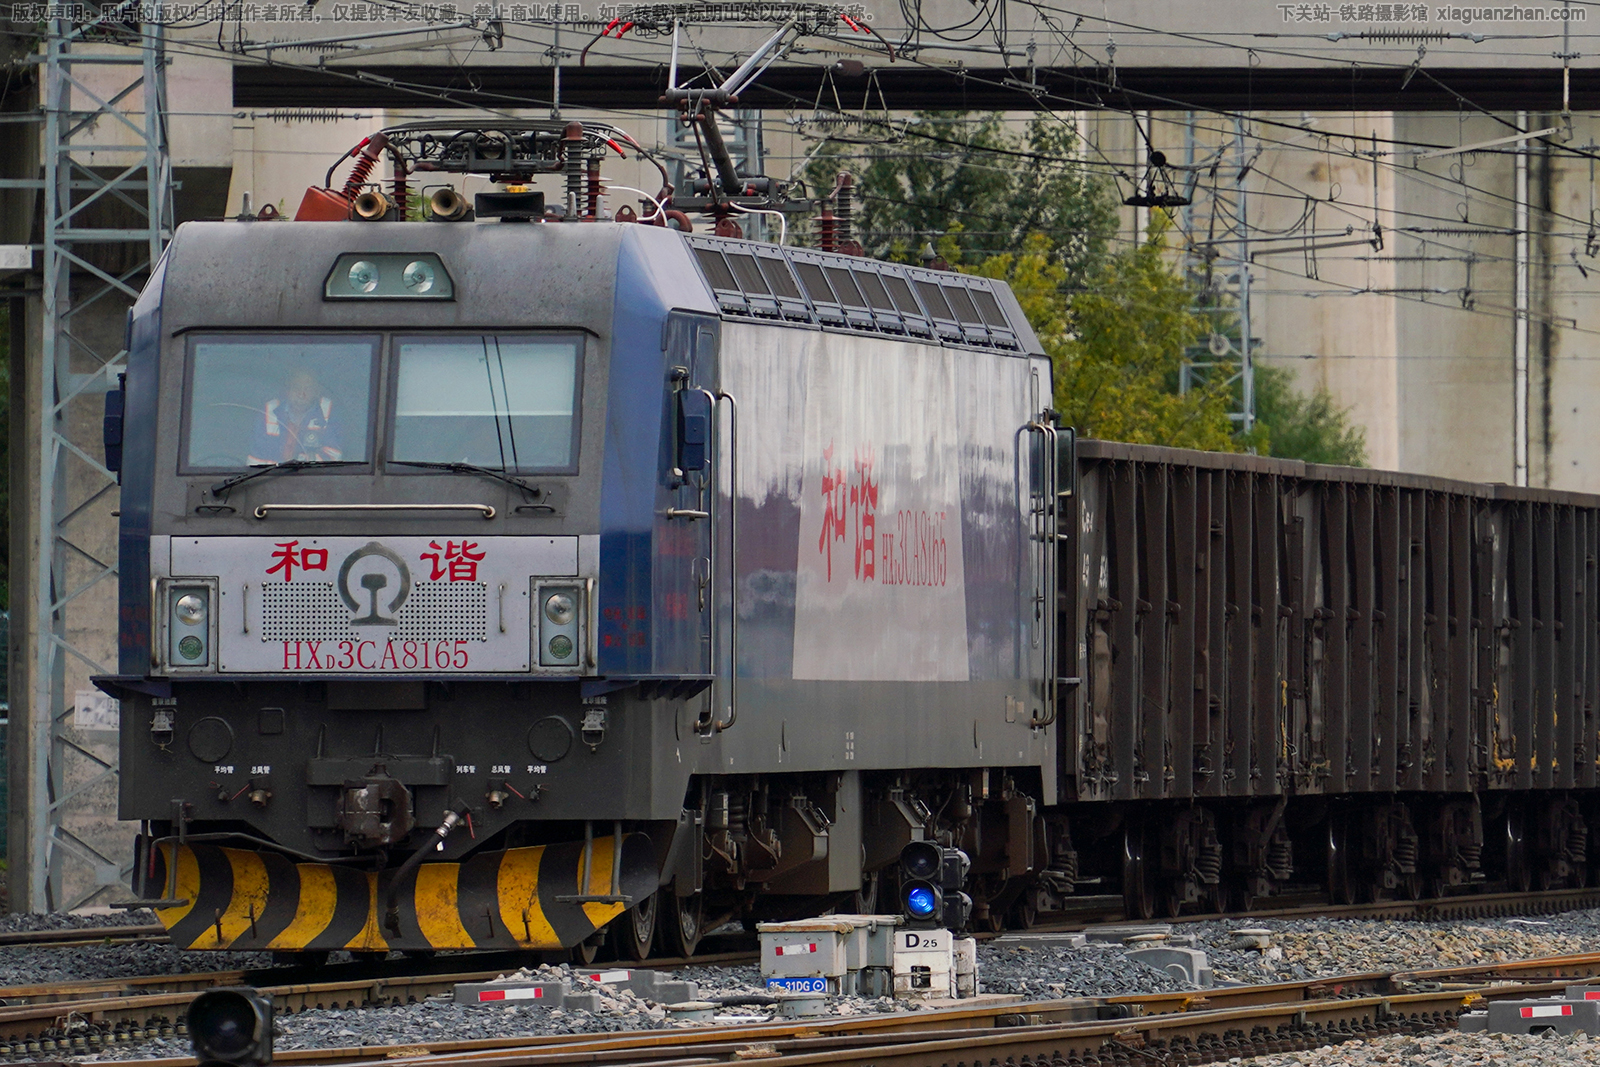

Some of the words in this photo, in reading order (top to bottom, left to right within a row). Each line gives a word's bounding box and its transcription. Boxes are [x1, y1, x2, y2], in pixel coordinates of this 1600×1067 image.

[818, 437, 878, 583] 和谐
[265, 540, 328, 582] 和
[419, 540, 486, 582] 谐
